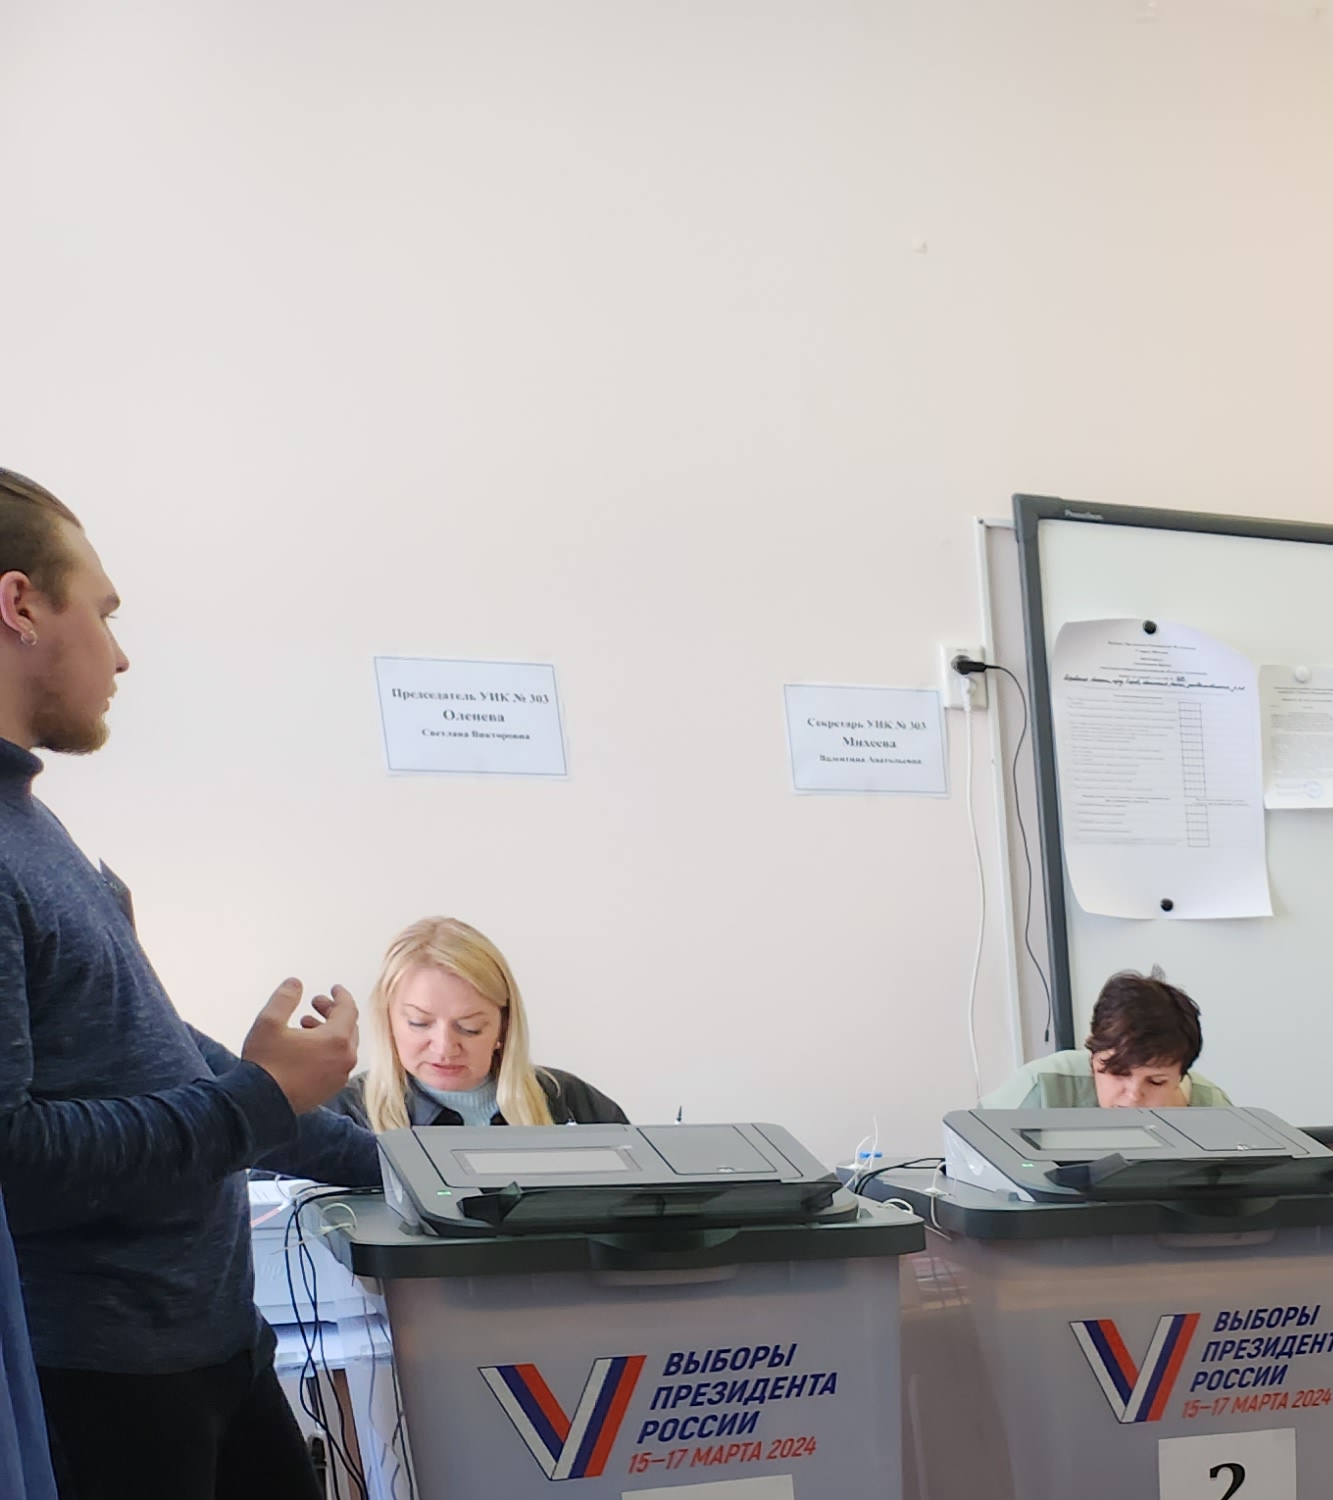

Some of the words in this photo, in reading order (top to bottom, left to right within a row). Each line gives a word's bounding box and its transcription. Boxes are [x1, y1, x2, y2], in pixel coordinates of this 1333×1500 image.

[391, 688, 477, 701] Председатель
[479, 691, 510, 703] УИК
[528, 693, 550, 705] 303
[1212, 1304, 1321, 1333] ВЫБОРЫ
[662, 1343, 798, 1377] ВЫБОРЫ
[649, 1372, 838, 1411] ПРЕЗИДЕНТА
[1189, 1364, 1289, 1393] РОССИИ
[1231, 1392, 1290, 1415] МАРТА
[1291, 1388, 1333, 1409] 2024
[637, 1411, 761, 1445] РОССИИ
[690, 1441, 763, 1468] МАРТА
[766, 1436, 817, 1460] 2024
